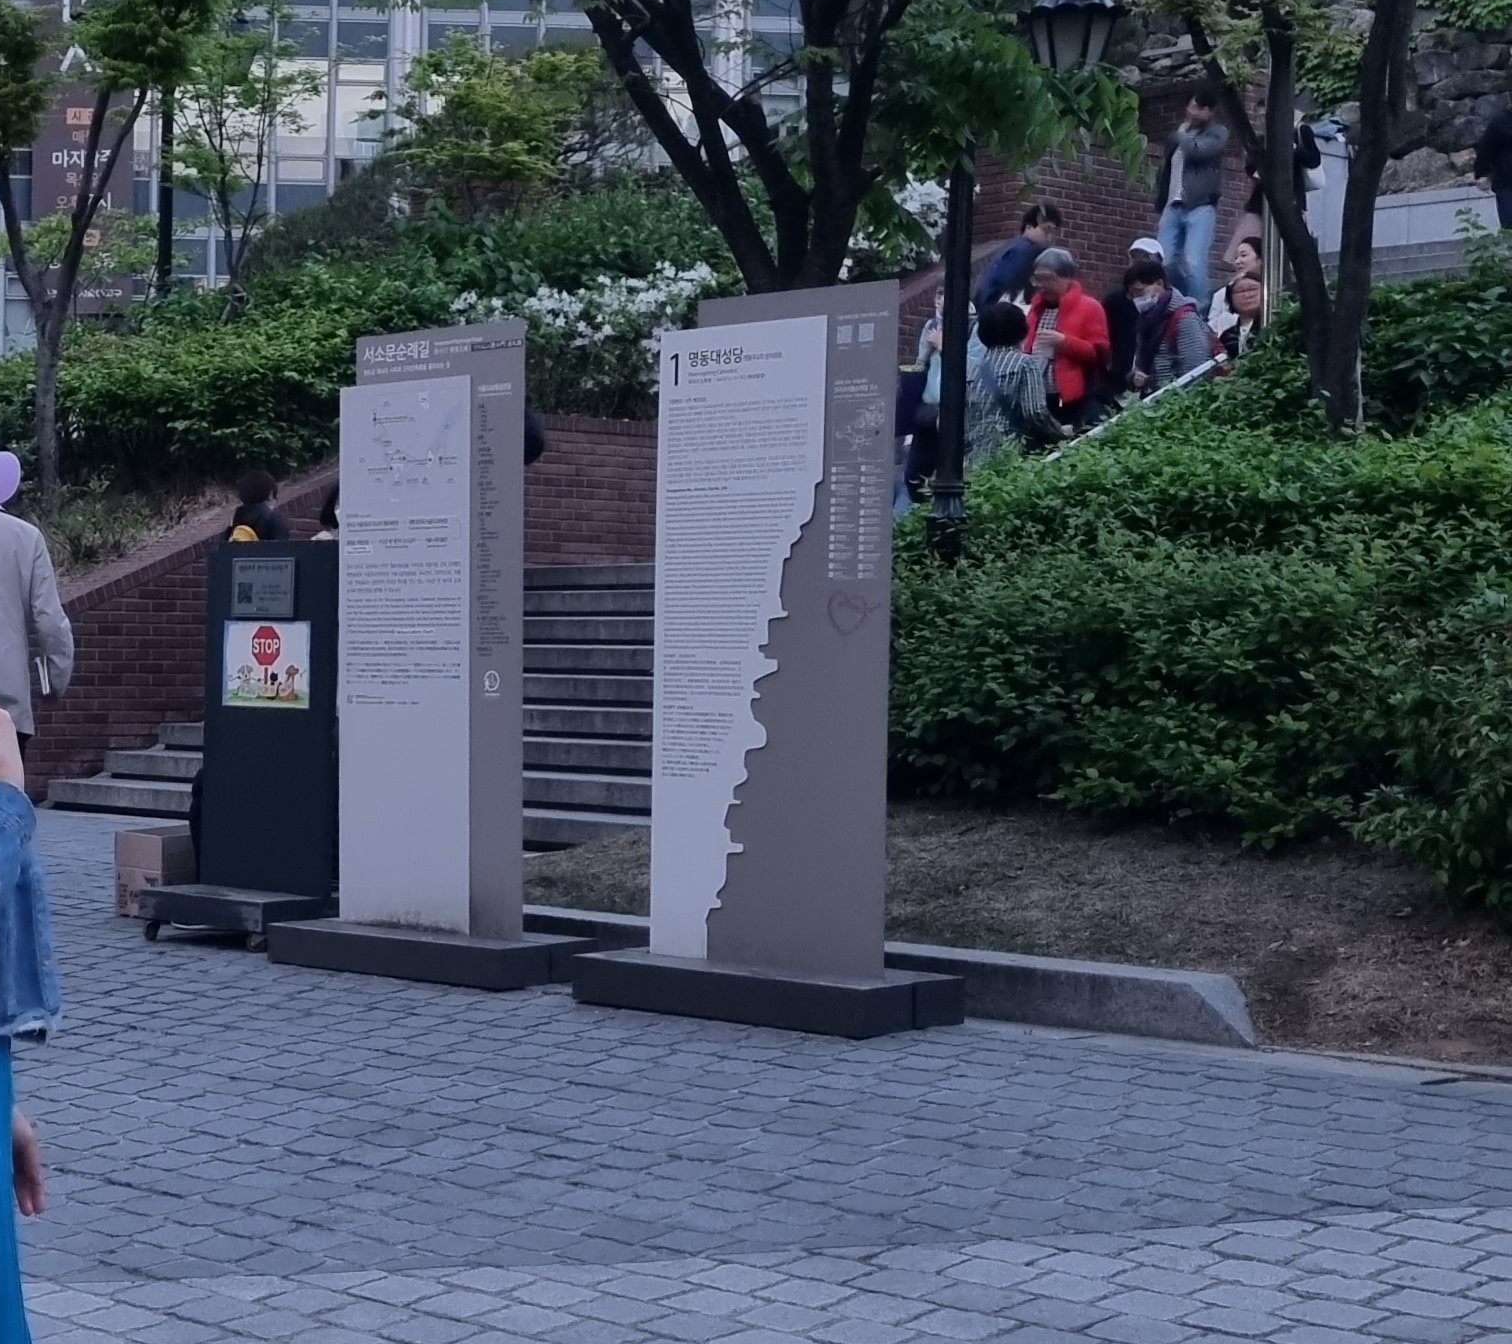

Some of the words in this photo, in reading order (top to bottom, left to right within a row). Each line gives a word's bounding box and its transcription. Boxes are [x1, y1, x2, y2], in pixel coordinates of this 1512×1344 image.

[52, 148, 112, 168] 마지
[363, 339, 430, 366] 서소문순례길
[688, 346, 744, 368] 명동대성당
[669, 352, 680, 387] 1
[252, 638, 280, 655] STOP
